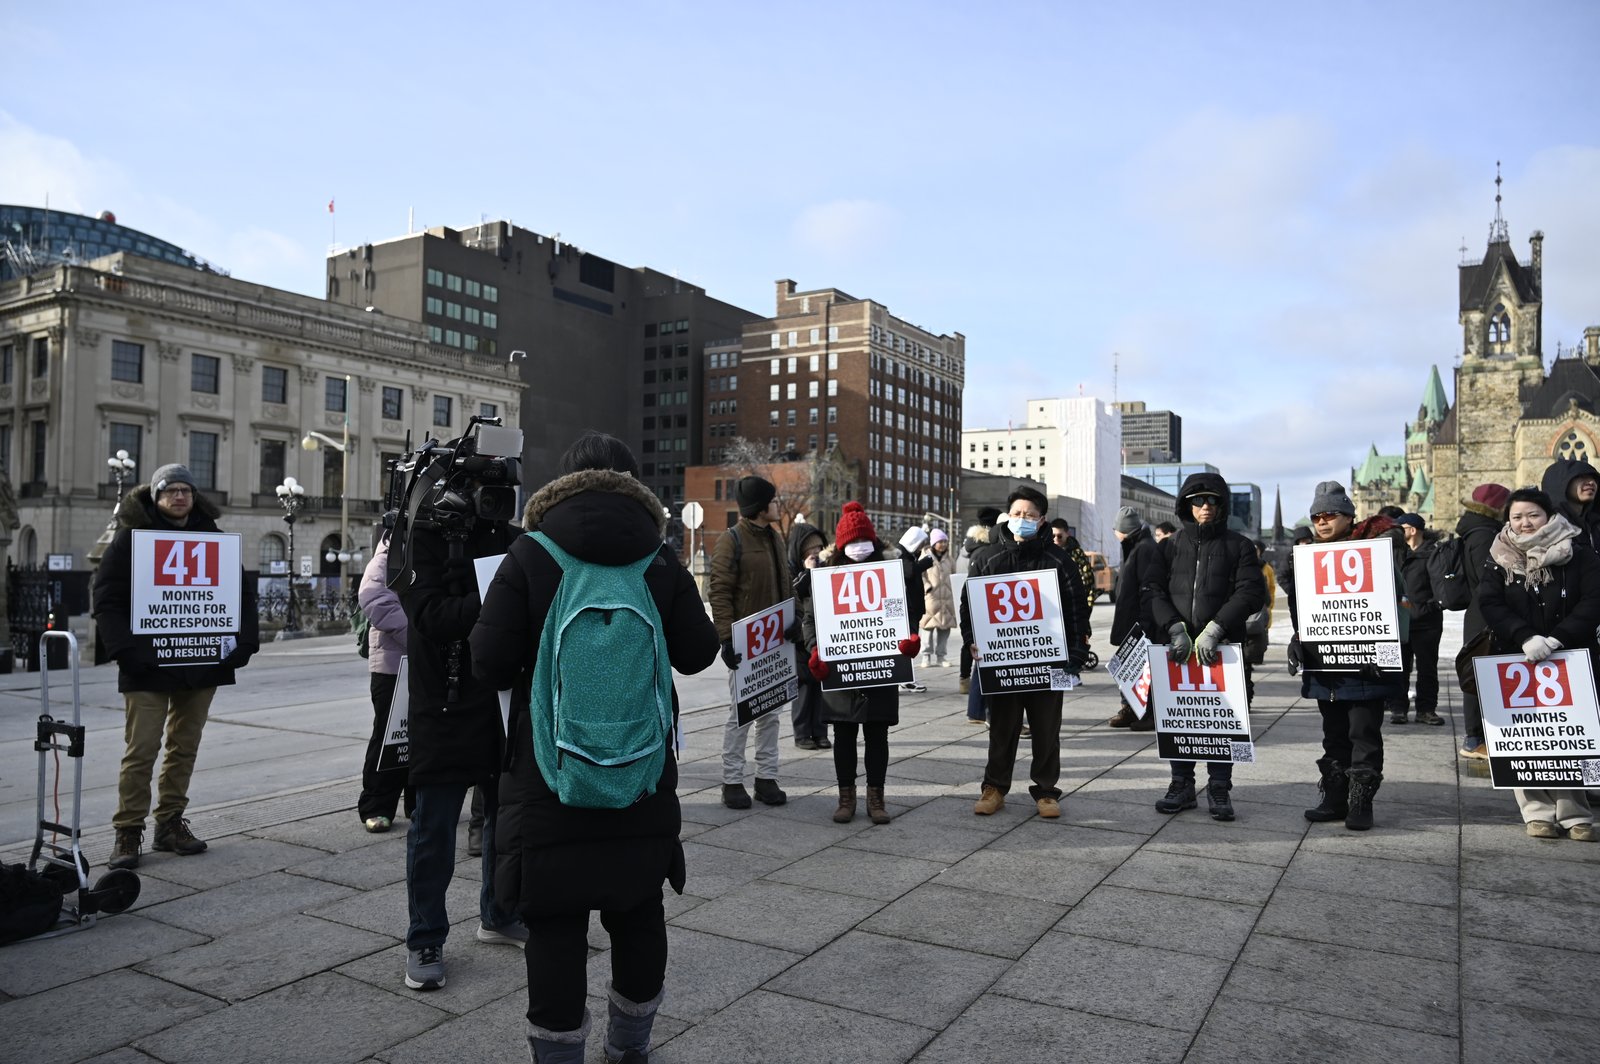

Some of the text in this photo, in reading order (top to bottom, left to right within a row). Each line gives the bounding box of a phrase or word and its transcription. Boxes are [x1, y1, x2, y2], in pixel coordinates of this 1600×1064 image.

[162, 541, 211, 585] 41
[303, 564, 311, 574] 30
[1321, 549, 1364, 593] 19
[162, 590, 214, 601] MONTHS
[838, 570, 881, 612] 40
[992, 580, 1036, 622] 39
[1322, 599, 1368, 610] MONTHS
[148, 604, 227, 614] WAITING FOR
[140, 617, 233, 628] IRCC RESPONSE
[840, 616, 883, 629] MONTHS
[1312, 612, 1382, 623] WAITING FOR
[751, 613, 780, 656] 32
[830, 628, 896, 643] WAITING FOR
[997, 625, 1040, 637] MONTHS
[1307, 625, 1390, 636] IRCC RESPONSE
[153, 636, 221, 647] NO TIMELINES
[987, 636, 1053, 650] WAITING FOR
[157, 647, 217, 658] NO RESULTS
[825, 646, 847, 656] IRCC
[983, 647, 1060, 662] IRCC RESPONSE
[1318, 644, 1376, 653] NO TIMELINE
[751, 651, 780, 671] MONTHS
[837, 659, 895, 672] NO TIMELINES
[1117, 639, 1145, 680] IRCC RESPONSE
[1122, 647, 1146, 683] WAITING FOR
[1323, 655, 1377, 664] NO RESULTS
[744, 658, 788, 685] WAITING FOR
[842, 670, 892, 682] NO RESULTS
[996, 665, 1051, 678] NO TIMELINES
[1129, 658, 1146, 683] MONTHS
[1176, 662, 1217, 690] 11
[740, 666, 793, 697] IRCC RESPONSE
[1000, 676, 1050, 687] NO RESULTS
[1505, 661, 1564, 707] 28
[749, 684, 787, 709] NO TIMELINES
[1176, 696, 1221, 706] MONTHS
[752, 693, 785, 715] NO RESULTS
[1167, 708, 1234, 718] WAITING FOR
[1511, 712, 1568, 724] MONTHS
[1162, 720, 1242, 730] IRCC RESPONSE
[1500, 725, 1585, 737] WAITING FOR
[1174, 736, 1232, 746] NO TIMELINES
[1495, 739, 1596, 751] IRCC RESPONSE
[397, 746, 408, 754] NO
[1178, 746, 1230, 755] NO RESULTS
[398, 754, 408, 762] NO
[1511, 760, 1525, 770] NO
[1517, 772, 1582, 781] NO RESULTS
